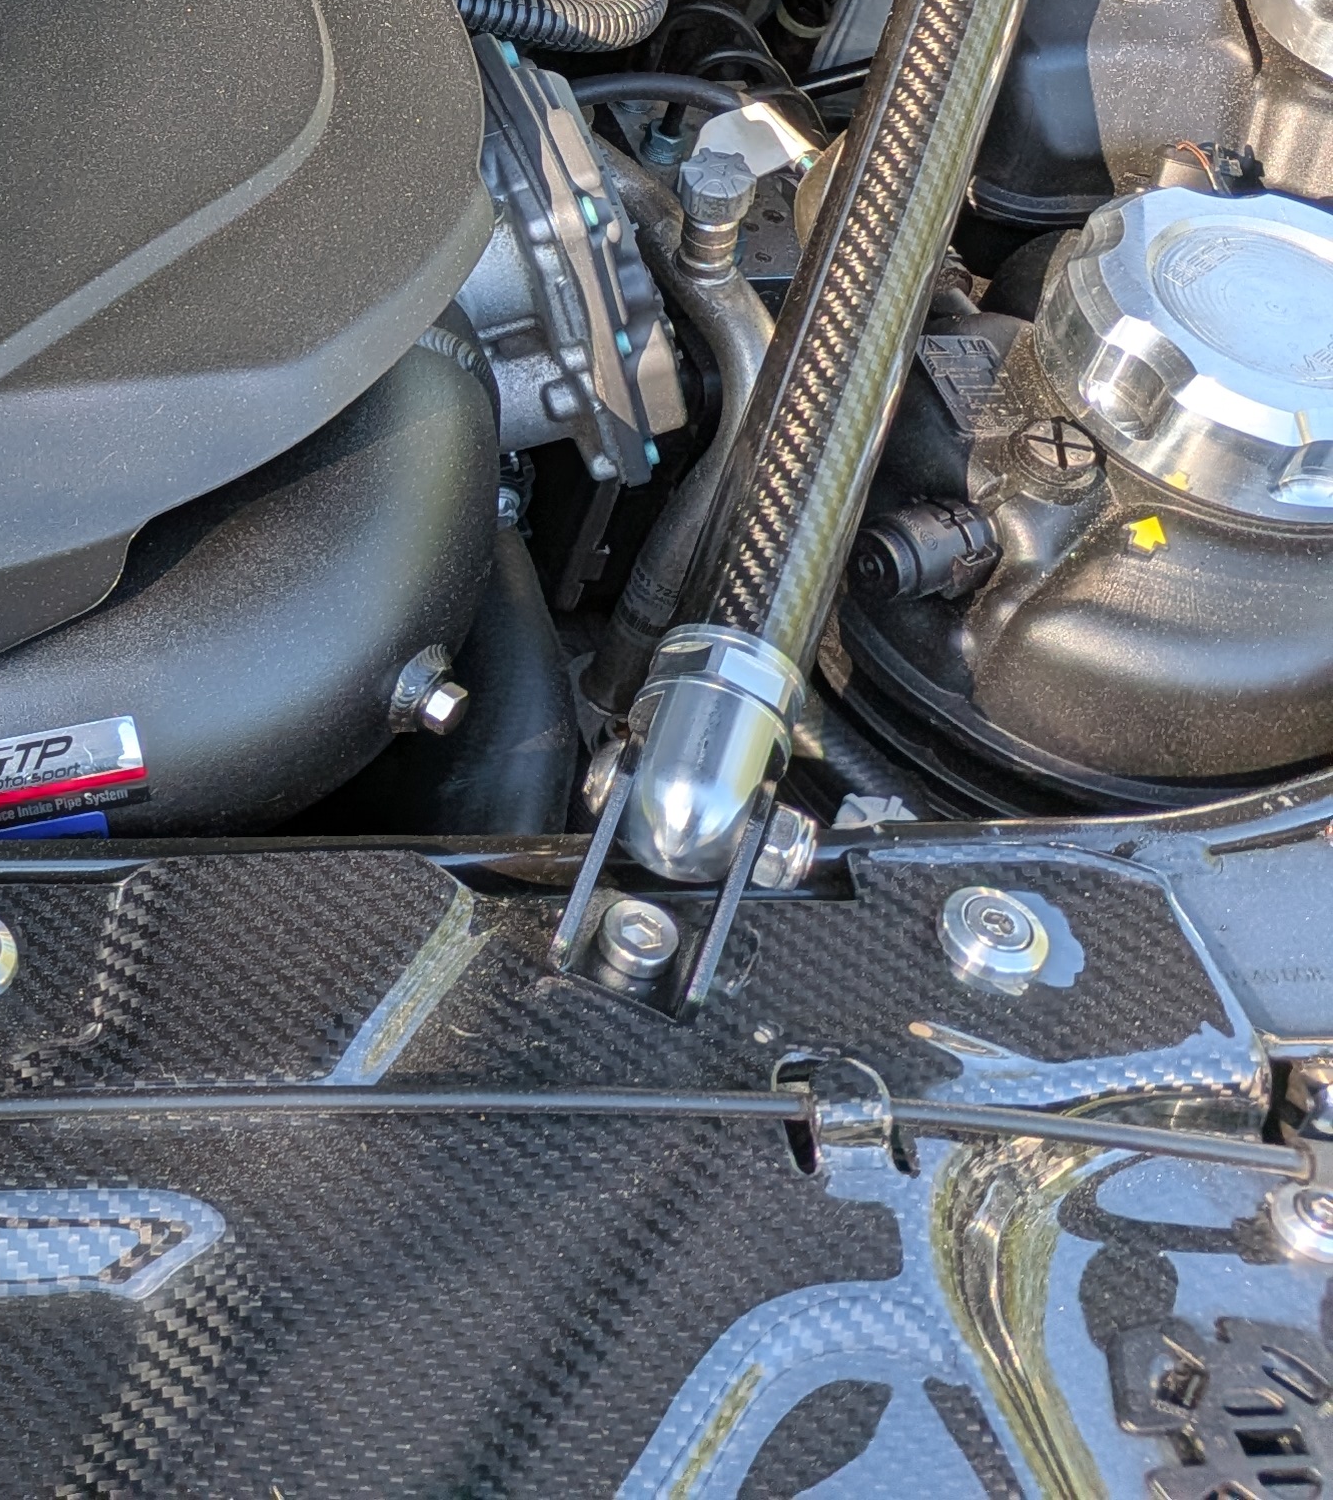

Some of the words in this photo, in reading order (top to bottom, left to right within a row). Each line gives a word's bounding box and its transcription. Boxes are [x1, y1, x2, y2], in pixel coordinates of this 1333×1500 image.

[16, 800, 54, 818] Intake
[54, 795, 83, 812] Pipe
[83, 786, 129, 807] System
